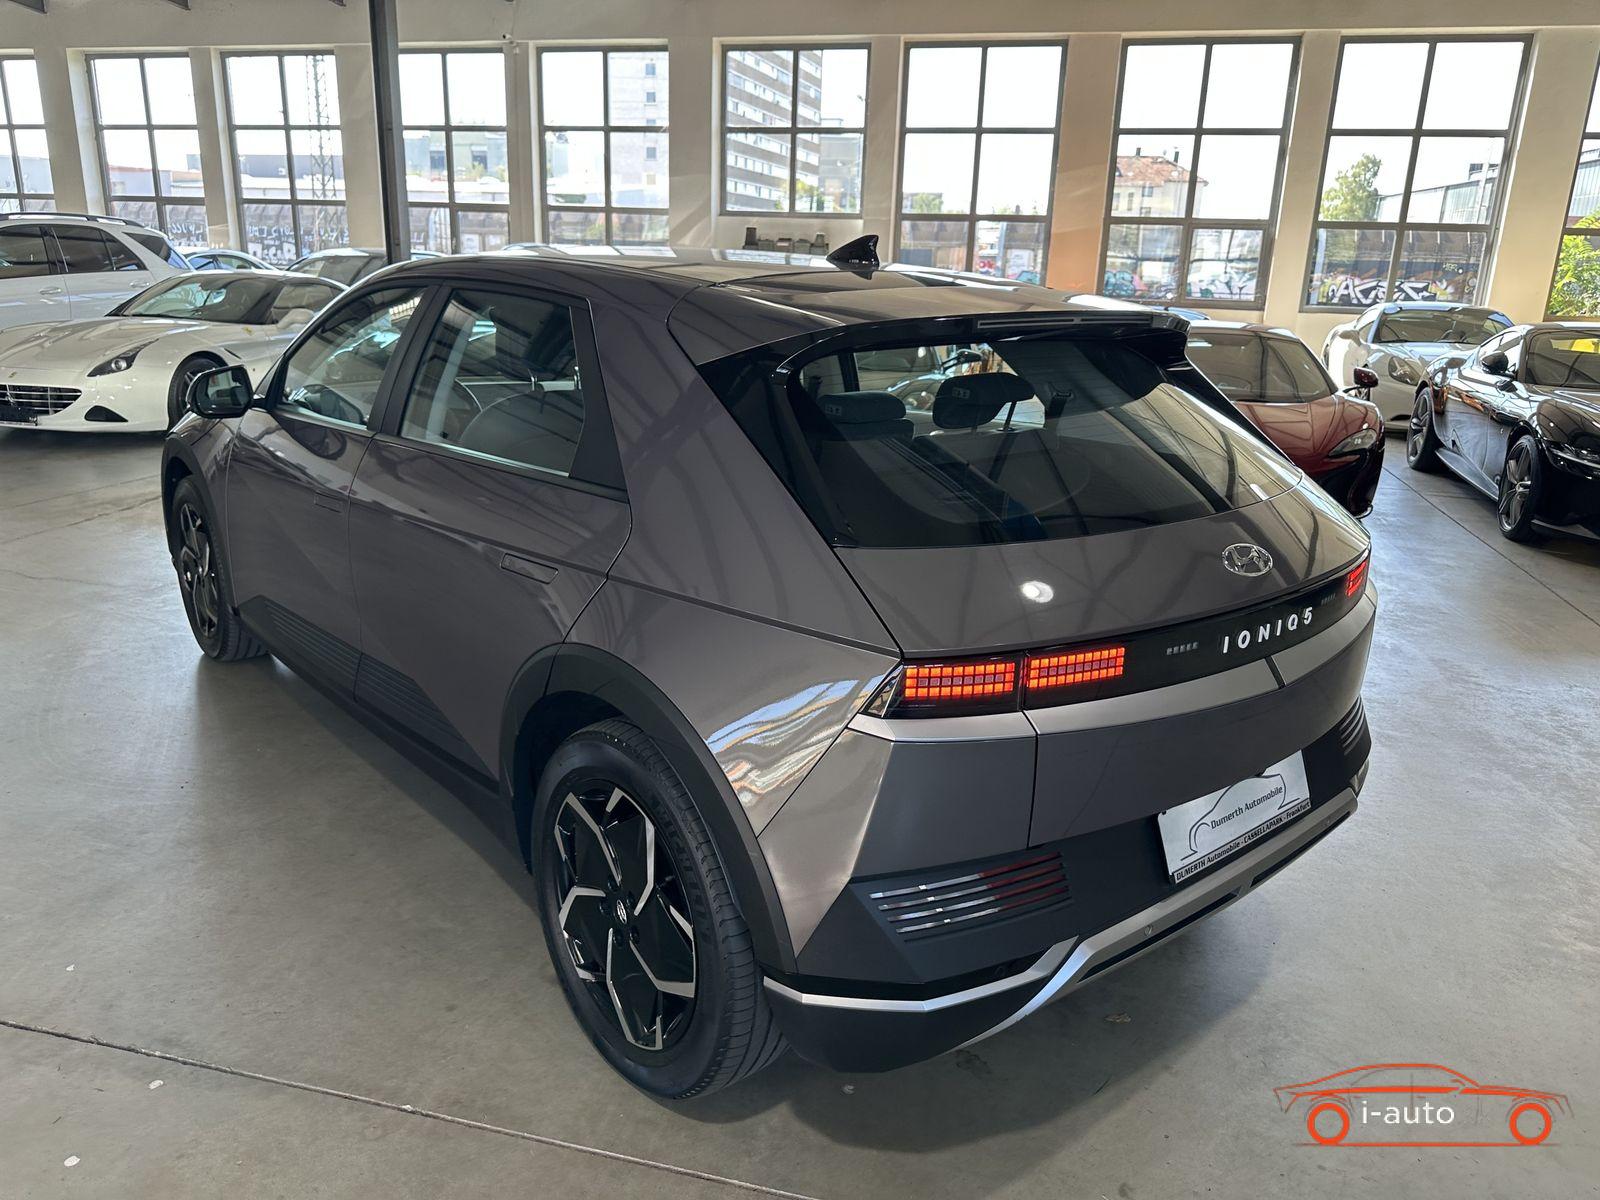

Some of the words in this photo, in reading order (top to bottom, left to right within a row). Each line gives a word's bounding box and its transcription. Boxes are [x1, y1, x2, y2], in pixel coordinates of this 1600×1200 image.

[1210, 807, 1244, 829] Dumerth
[1244, 786, 1283, 811] Automobile
[1176, 859, 1206, 881] DUMERTH
[1206, 839, 1240, 863] Automobile
[1243, 815, 1283, 843] CASSELLAPARK
[1286, 801, 1311, 820] Frankfurt
